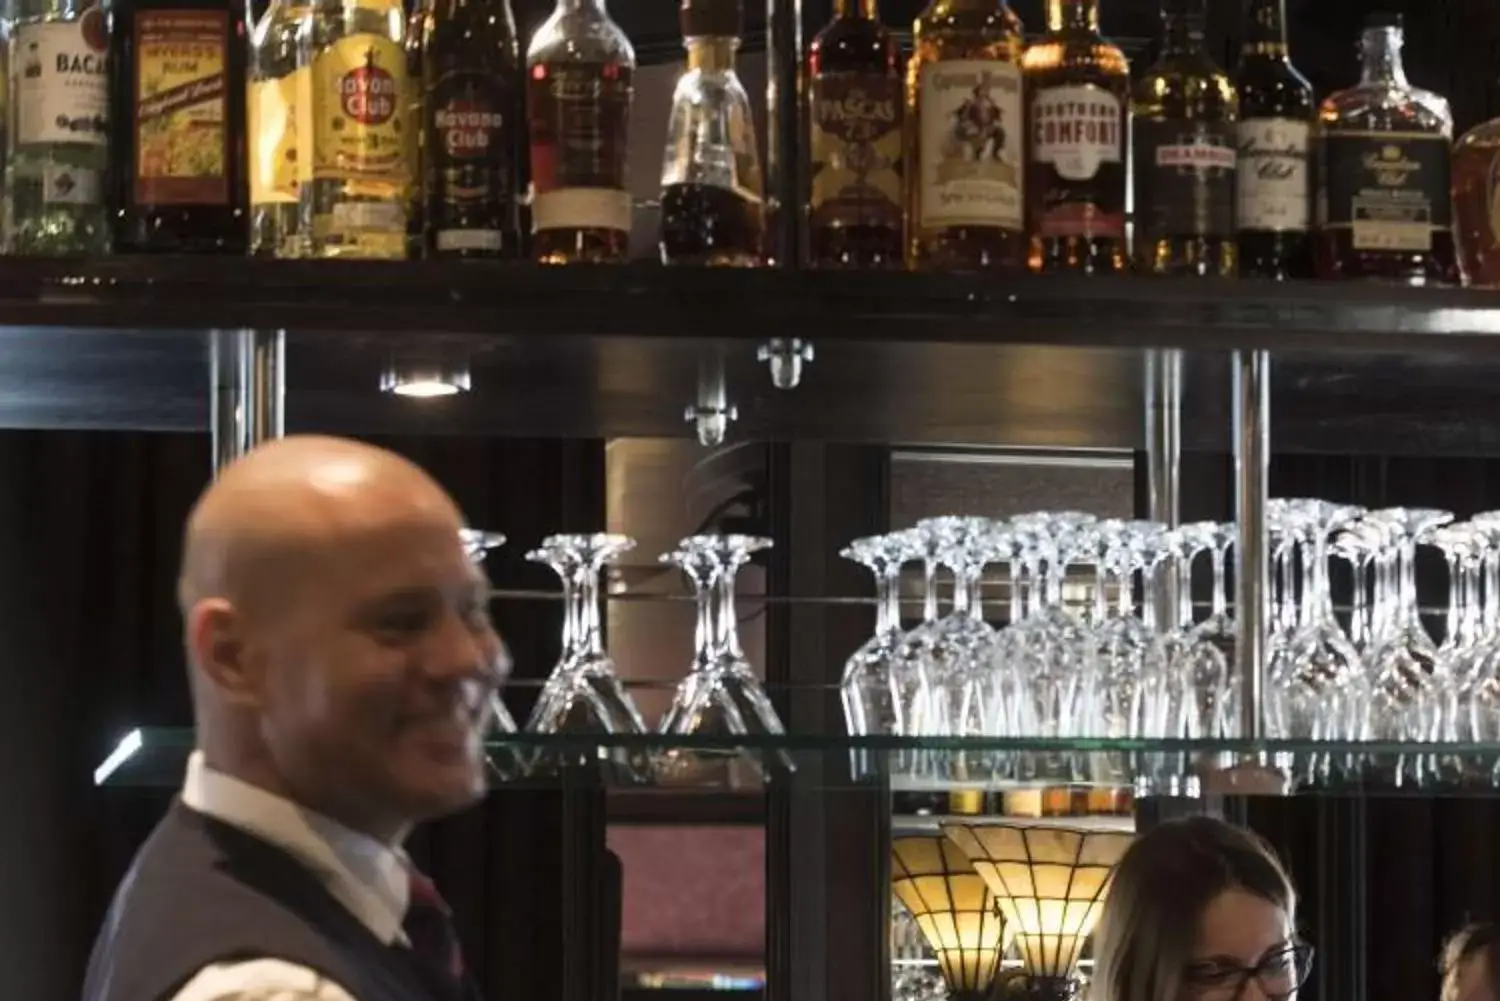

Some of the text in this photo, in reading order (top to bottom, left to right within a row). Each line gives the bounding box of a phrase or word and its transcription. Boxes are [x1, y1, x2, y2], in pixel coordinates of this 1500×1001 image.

[347, 97, 390, 116] Club
[435, 110, 502, 128] Havana
[448, 128, 488, 148] Club
[1035, 120, 1117, 145] COMFORT
